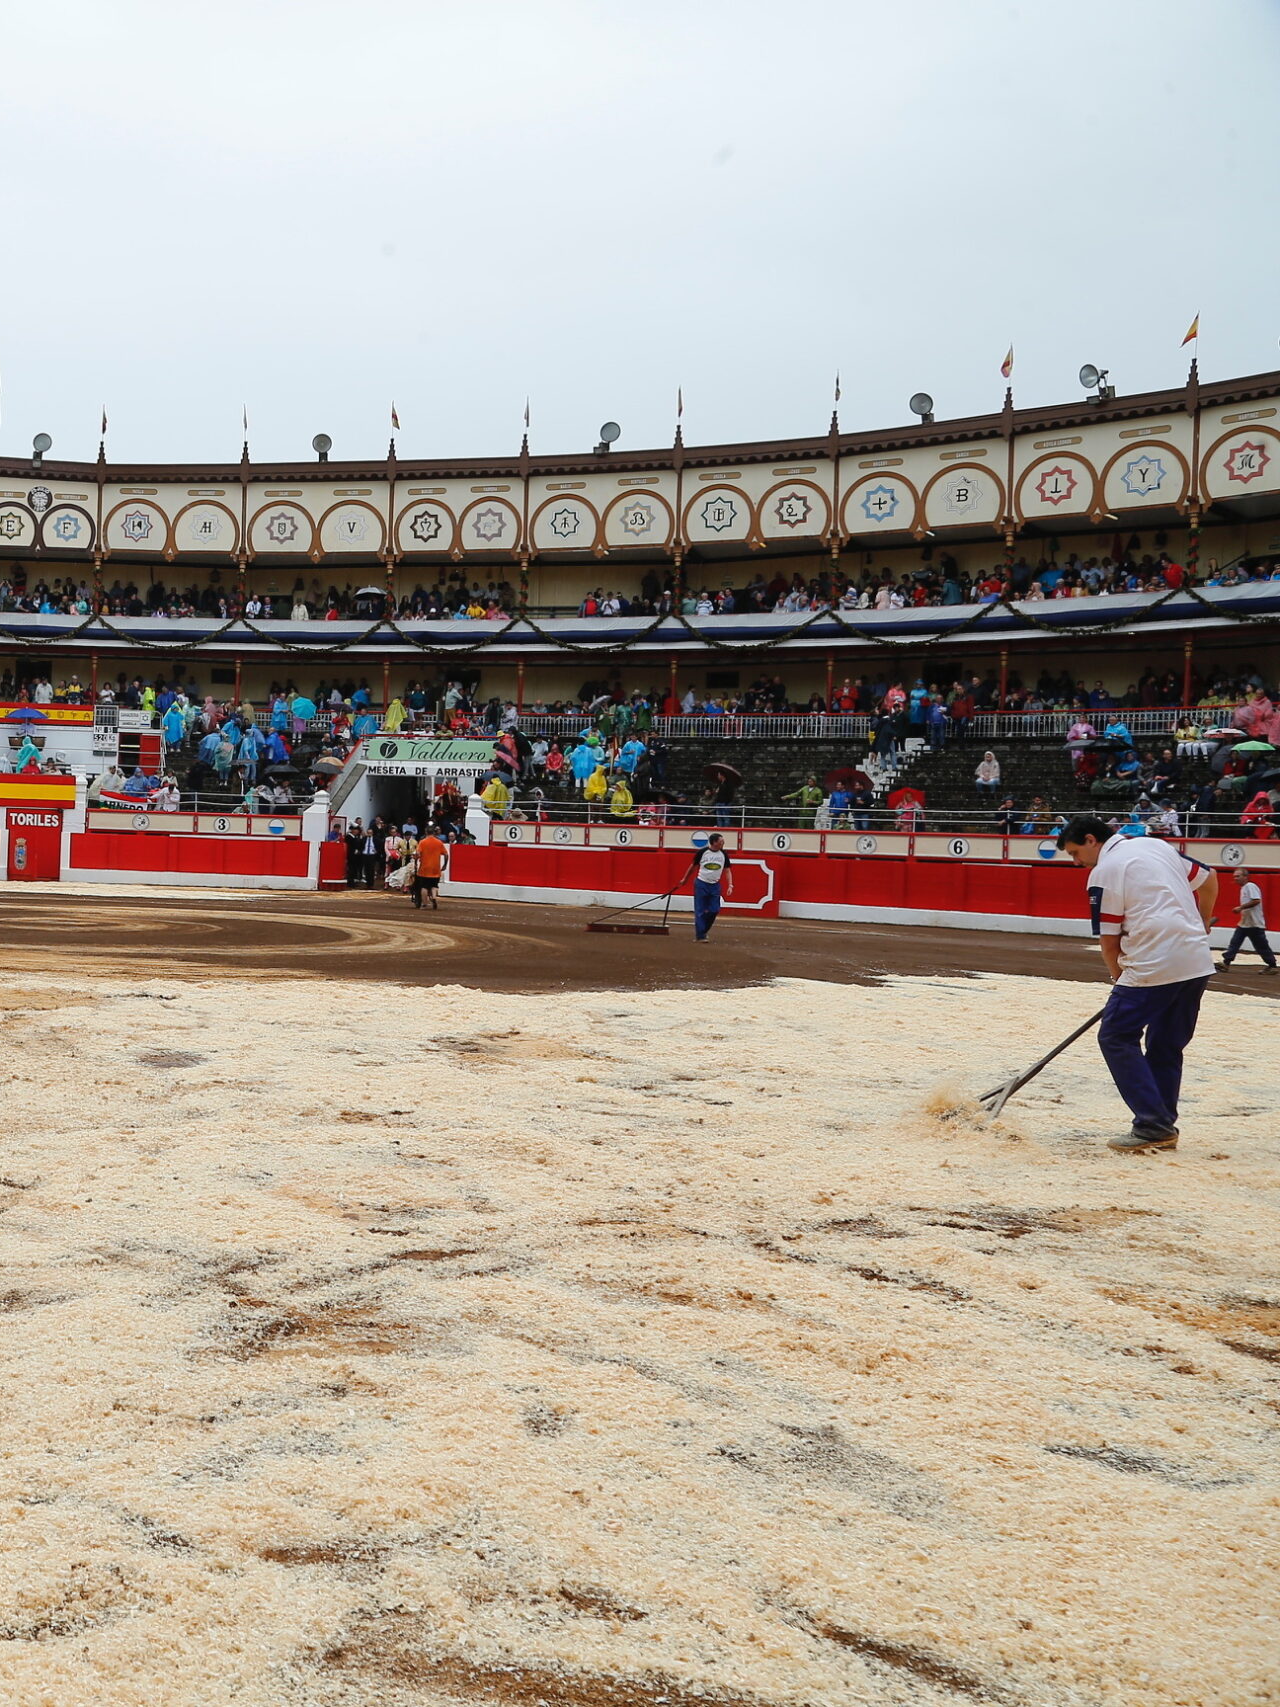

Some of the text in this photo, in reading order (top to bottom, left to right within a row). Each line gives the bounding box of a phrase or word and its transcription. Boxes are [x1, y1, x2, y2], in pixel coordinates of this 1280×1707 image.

[1139, 468, 1150, 483] Y
[955, 488, 969, 502] B
[6, 520, 15, 532] E
[62, 522, 72, 533] F
[347, 521, 357, 534] V
[407, 741, 486, 761] Valduero
[368, 766, 406, 775] MESETA
[415, 767, 428, 775] DE
[10, 813, 59, 827] TORILES
[218, 818, 225, 831] 3
[509, 827, 517, 839] 6
[619, 831, 627, 843] 6
[777, 835, 785, 848] 6
[953, 841, 962, 854] 6
